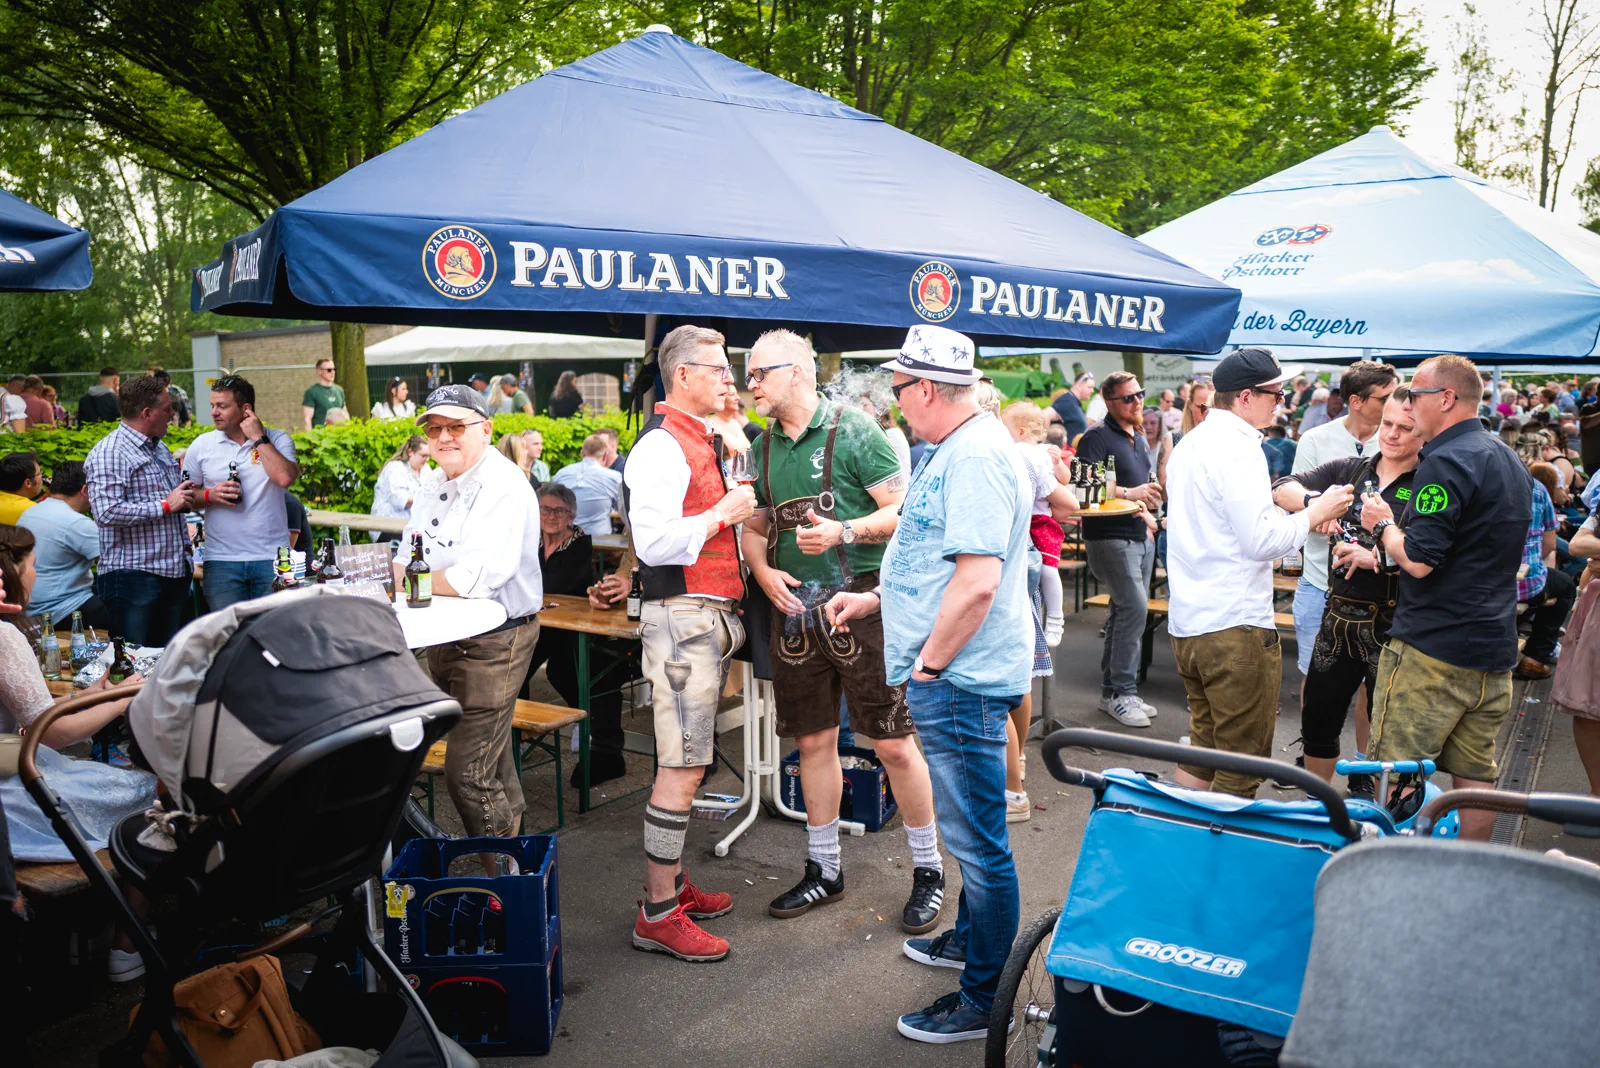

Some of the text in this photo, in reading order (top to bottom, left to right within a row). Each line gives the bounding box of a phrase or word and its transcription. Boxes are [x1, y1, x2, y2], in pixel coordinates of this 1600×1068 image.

[427, 228, 490, 256] PAULANER
[508, 240, 790, 300] PAULANER
[1233, 250, 1315, 267] Hacker
[913, 264, 957, 287] PAULANER
[1221, 264, 1305, 281] Pschorr
[434, 278, 488, 297] MÜNCHEN
[916, 303, 954, 322] MÜNCHEN
[968, 275, 1166, 333] PAULANER
[1243, 310, 1278, 331] der
[1281, 309, 1369, 339] Bayern
[1145, 373, 1188, 382] etränkeh
[893, 582, 919, 597] TOMPSON
[399, 906, 411, 963] Hacker-Psc
[1126, 938, 1246, 977] CROOZER
